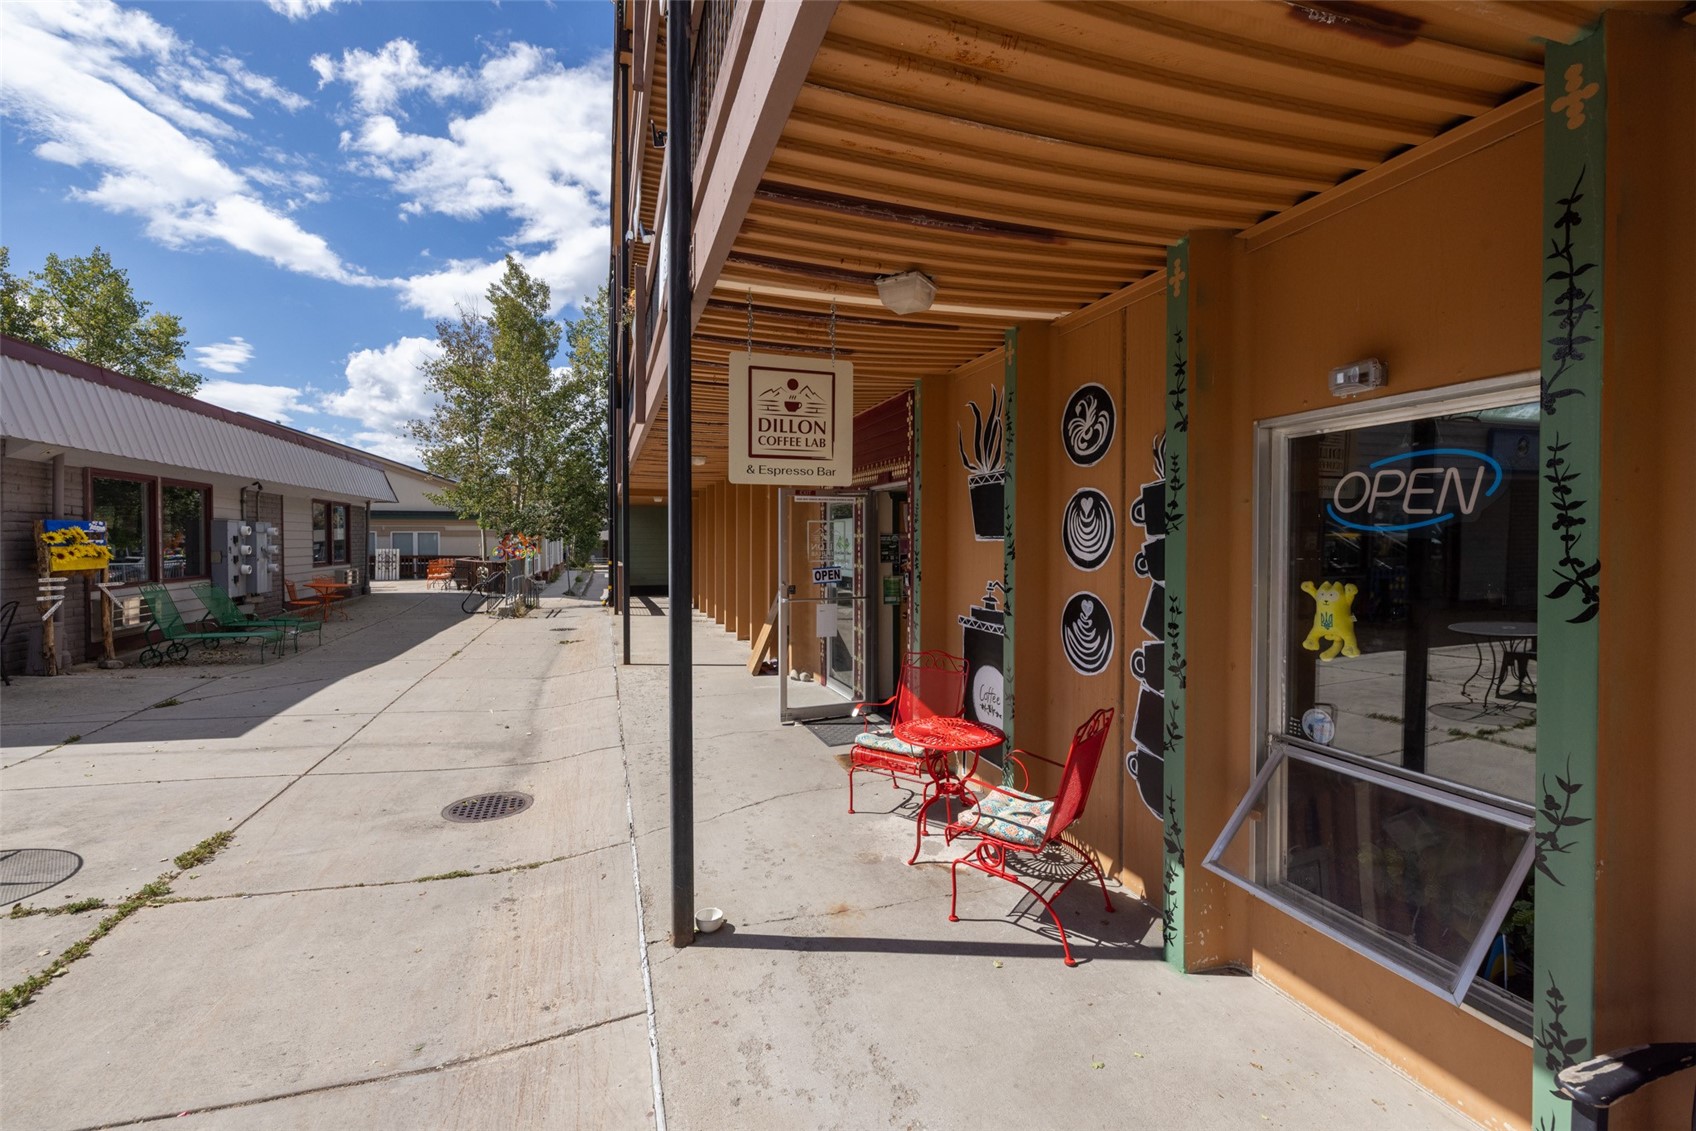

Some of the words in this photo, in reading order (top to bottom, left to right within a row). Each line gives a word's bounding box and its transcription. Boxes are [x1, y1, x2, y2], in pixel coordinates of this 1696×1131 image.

[758, 417, 826, 435] DILLON
[758, 435, 801, 447] COFFEE
[805, 437, 826, 448] LAB
[746, 464, 755, 475] &
[758, 465, 814, 477] Espresso
[817, 467, 836, 477] Bar
[1333, 465, 1485, 515] OPEN
[814, 569, 841, 581] OPEN
[979, 684, 1001, 706] Coffee
